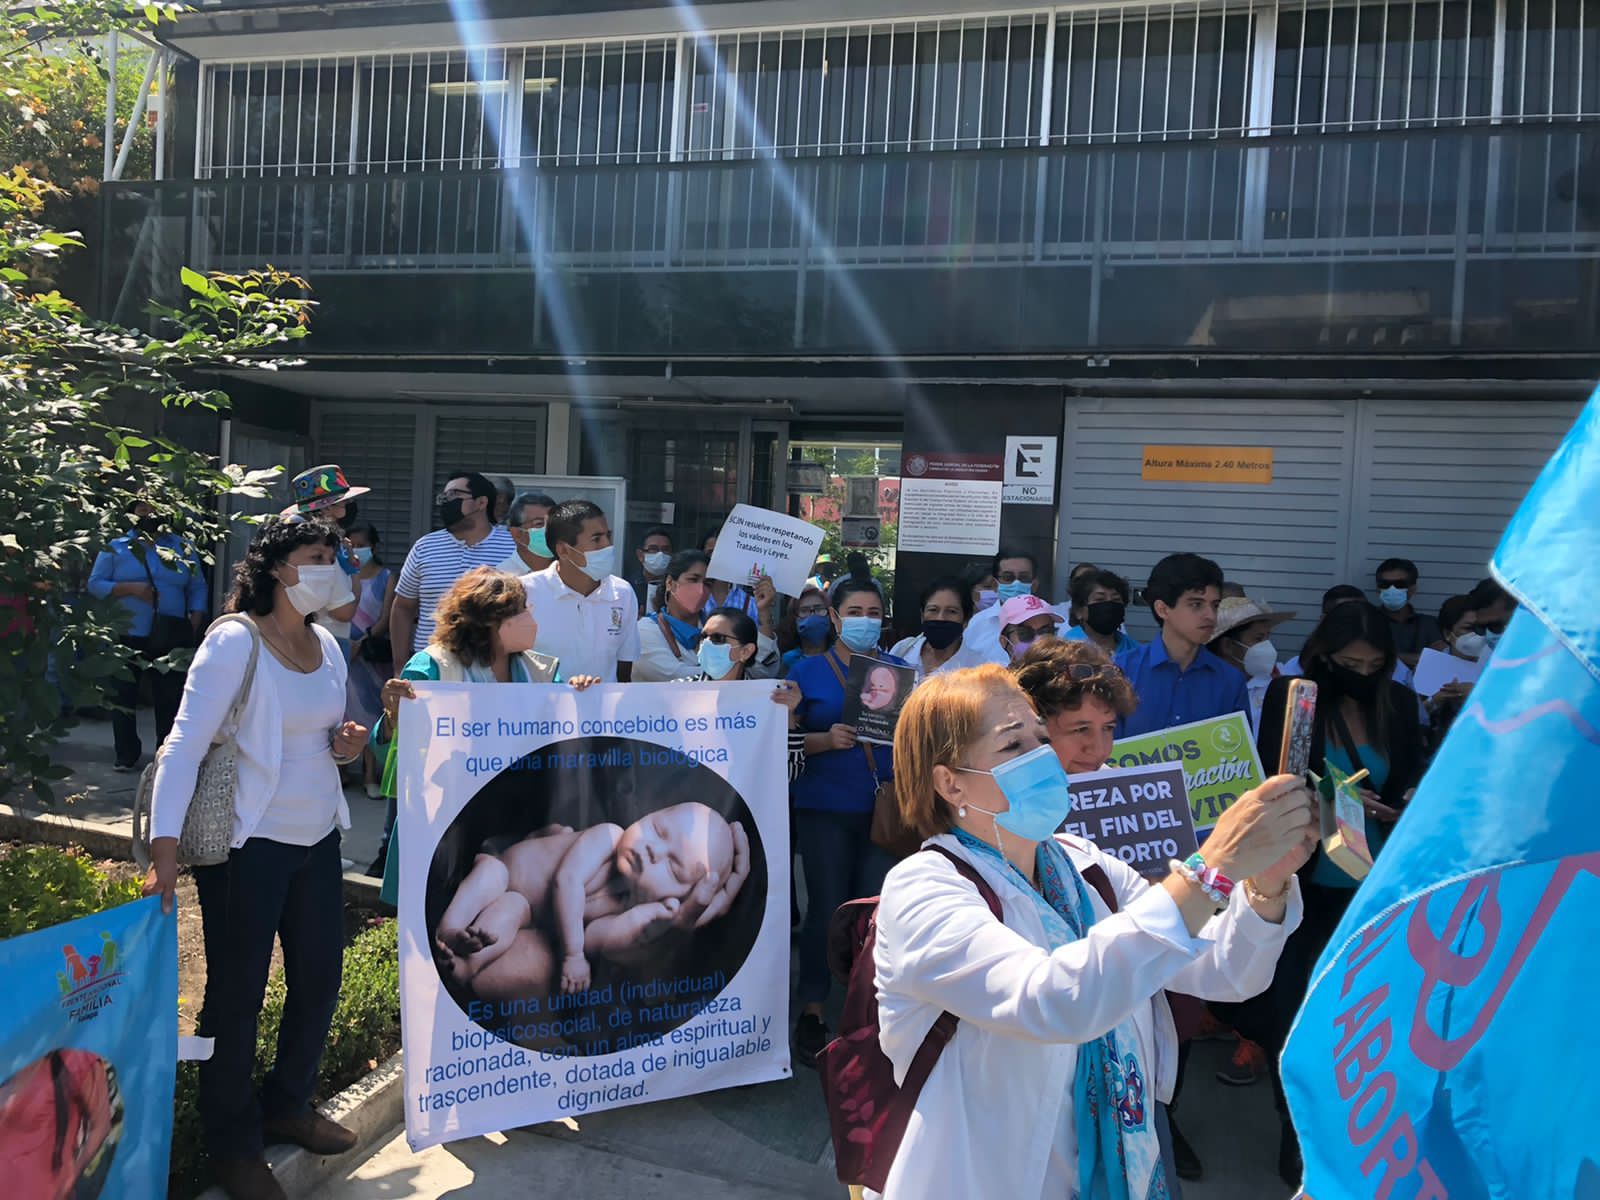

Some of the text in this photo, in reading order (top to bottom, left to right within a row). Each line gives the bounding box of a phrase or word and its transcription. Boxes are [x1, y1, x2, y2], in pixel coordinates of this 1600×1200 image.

[1144, 459, 1173, 468] Altura
[1215, 460, 1234, 469] 2.40
[1236, 460, 1271, 470] Metros
[1022, 487, 1037, 495] NO
[736, 540, 762, 554] Tratados
[738, 529, 748, 539] los
[749, 533, 771, 544] valores
[781, 539, 793, 550] los
[744, 519, 771, 532] resuelve
[771, 526, 814, 546] respetando
[436, 711, 757, 737] El ser humano concebido es más
[466, 745, 729, 777] que una maravilla biológica
[1069, 780, 1174, 812] REZA POR
[1064, 808, 1183, 840] EL FIN DEL
[69, 994, 113, 1020] FAMILIA
[467, 969, 727, 1022] Es una unidad (individual)
[608, 1007, 632, 1029] de
[639, 995, 742, 1024] naturaleza
[425, 1015, 772, 1084] racionada, con un alma espiritual y
[418, 1037, 772, 1113] trascendente, dotada de inigualable
[557, 1079, 650, 1111] dignidad.
